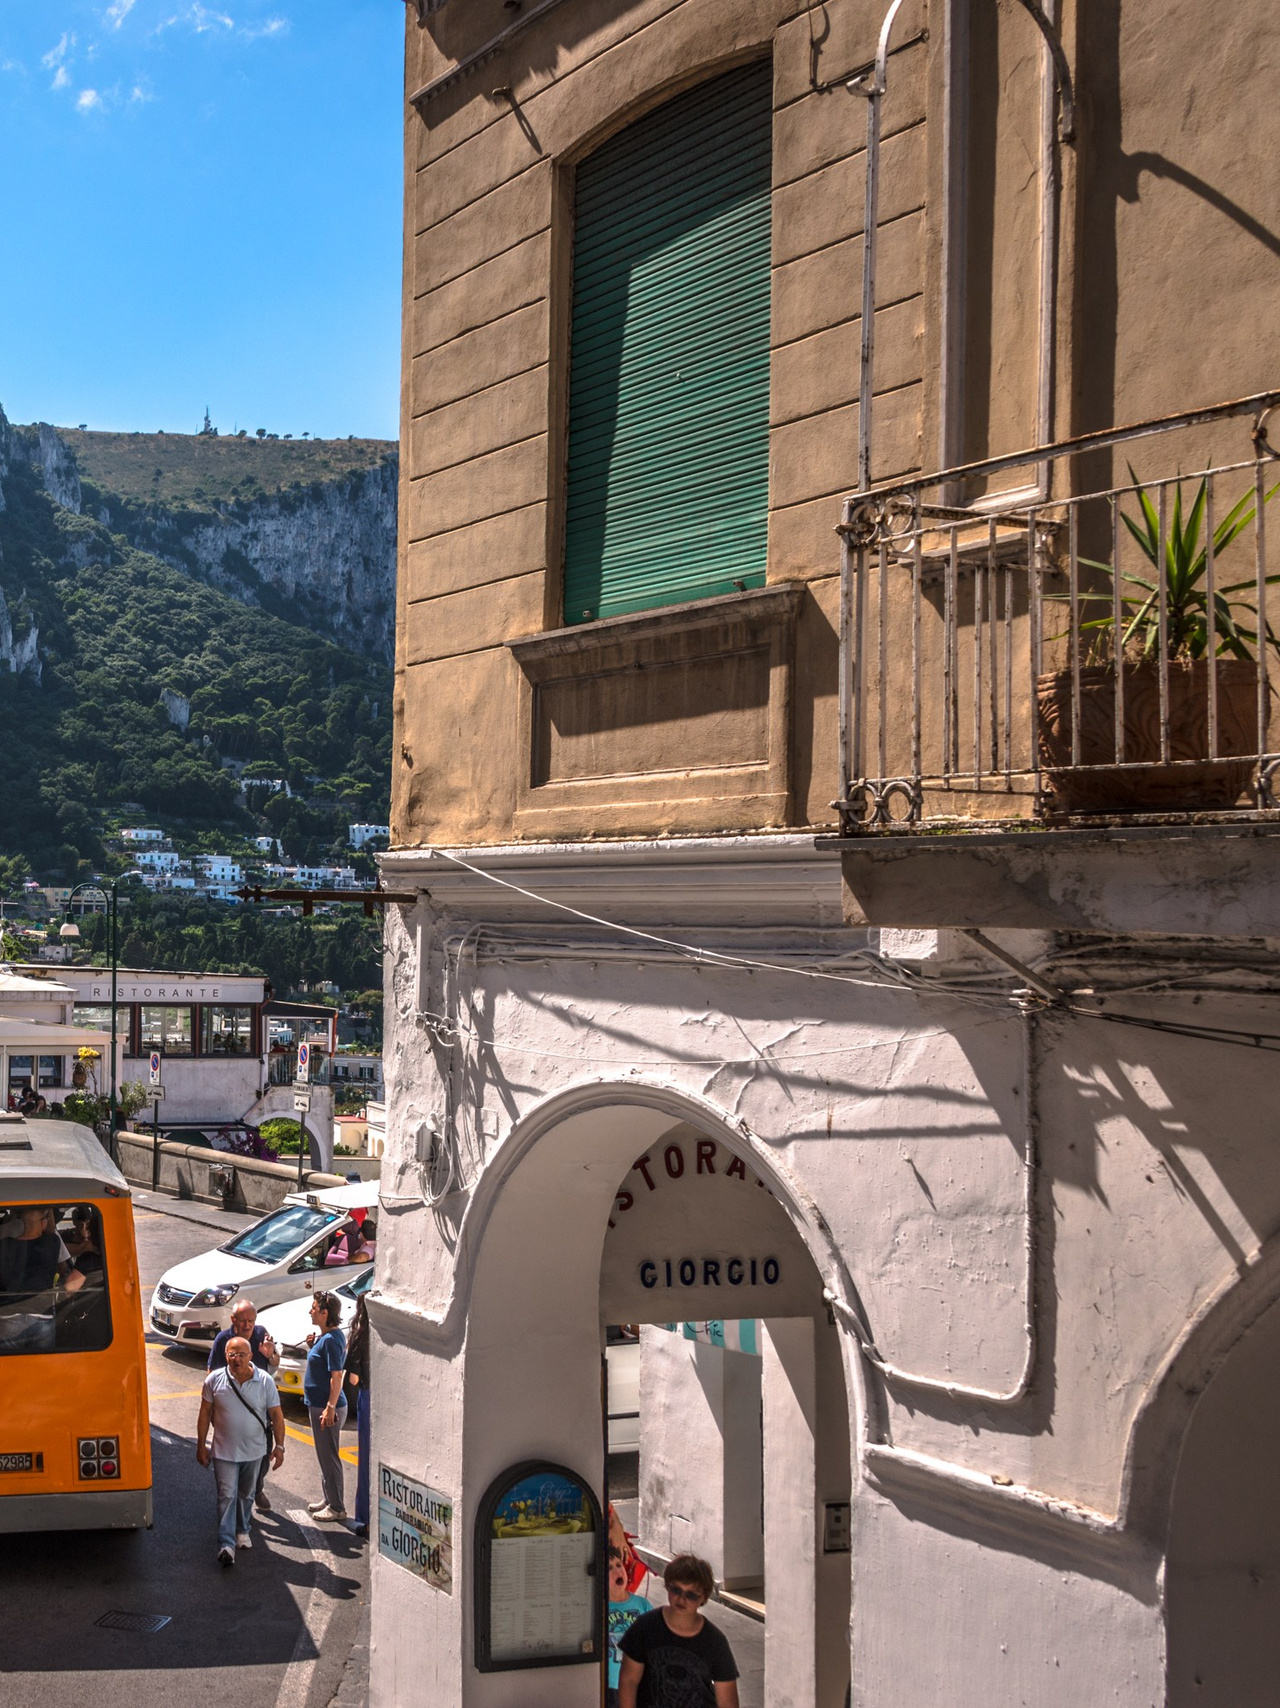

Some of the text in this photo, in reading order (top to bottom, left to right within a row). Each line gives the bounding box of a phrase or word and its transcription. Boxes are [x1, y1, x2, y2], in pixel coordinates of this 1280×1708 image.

[93, 988, 219, 997] RISTORANTE
[640, 1258, 780, 1289] GIORGIO
[382, 1468, 449, 1528] RISTORANTE
[392, 1526, 440, 1575] GIORGIO
